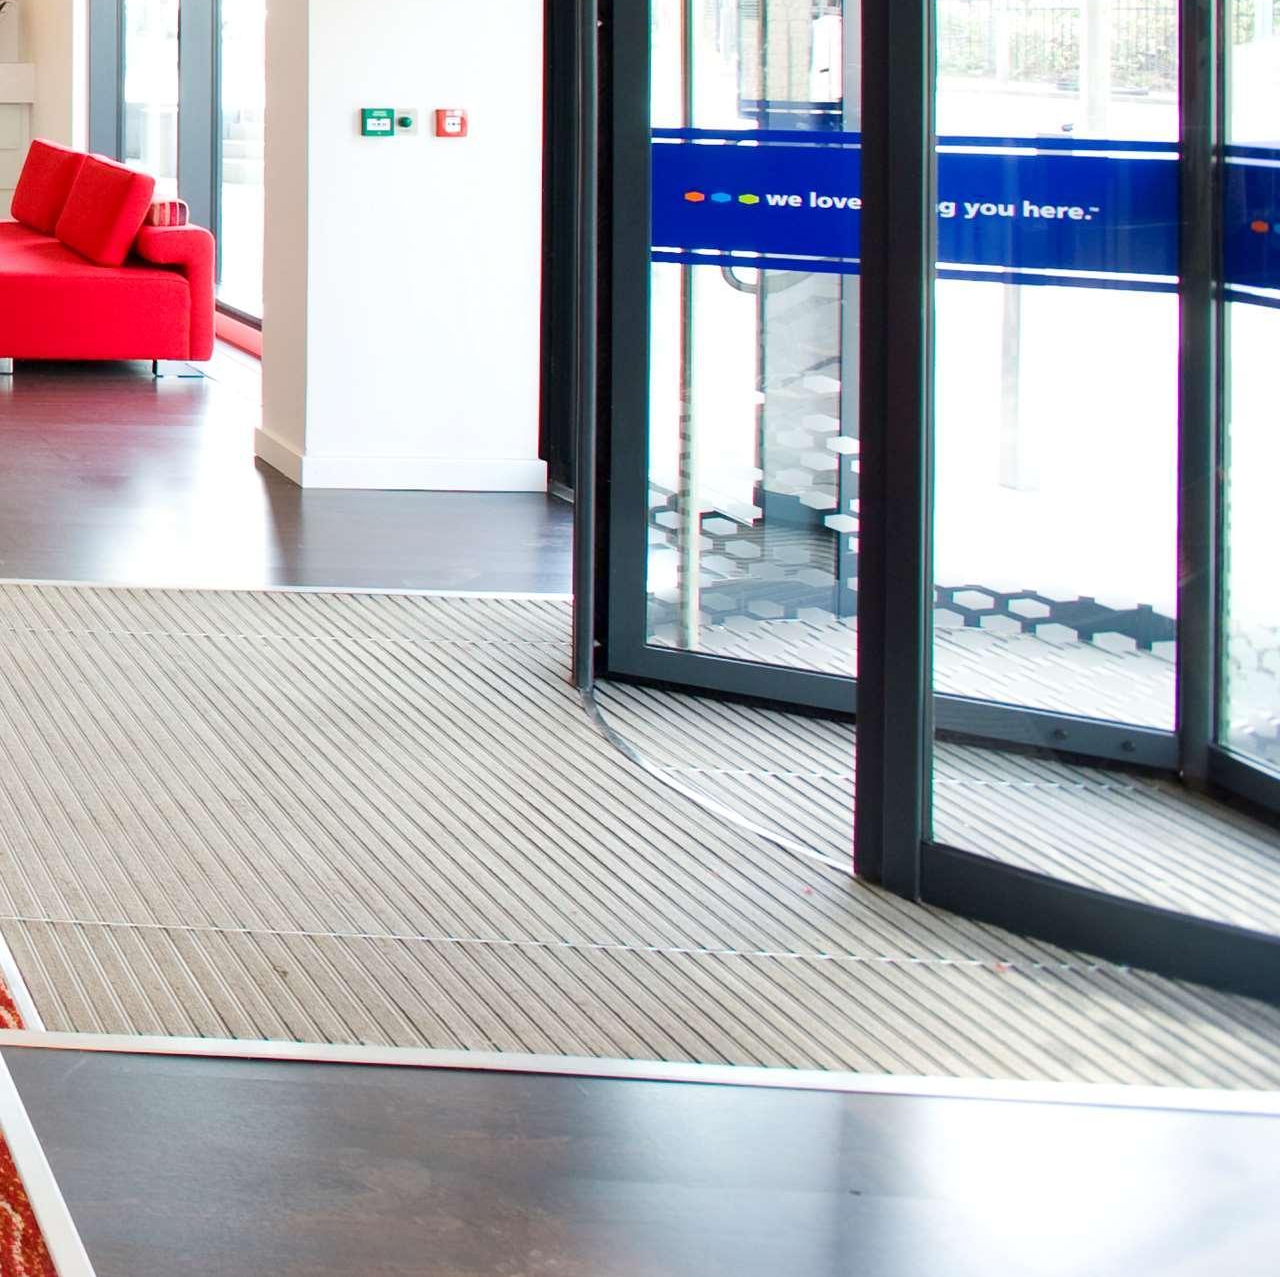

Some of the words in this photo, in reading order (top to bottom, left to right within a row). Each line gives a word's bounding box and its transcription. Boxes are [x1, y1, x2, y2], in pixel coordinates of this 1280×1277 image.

[765, 194, 803, 207] we
[809, 191, 862, 210] love
[963, 202, 1015, 219] you
